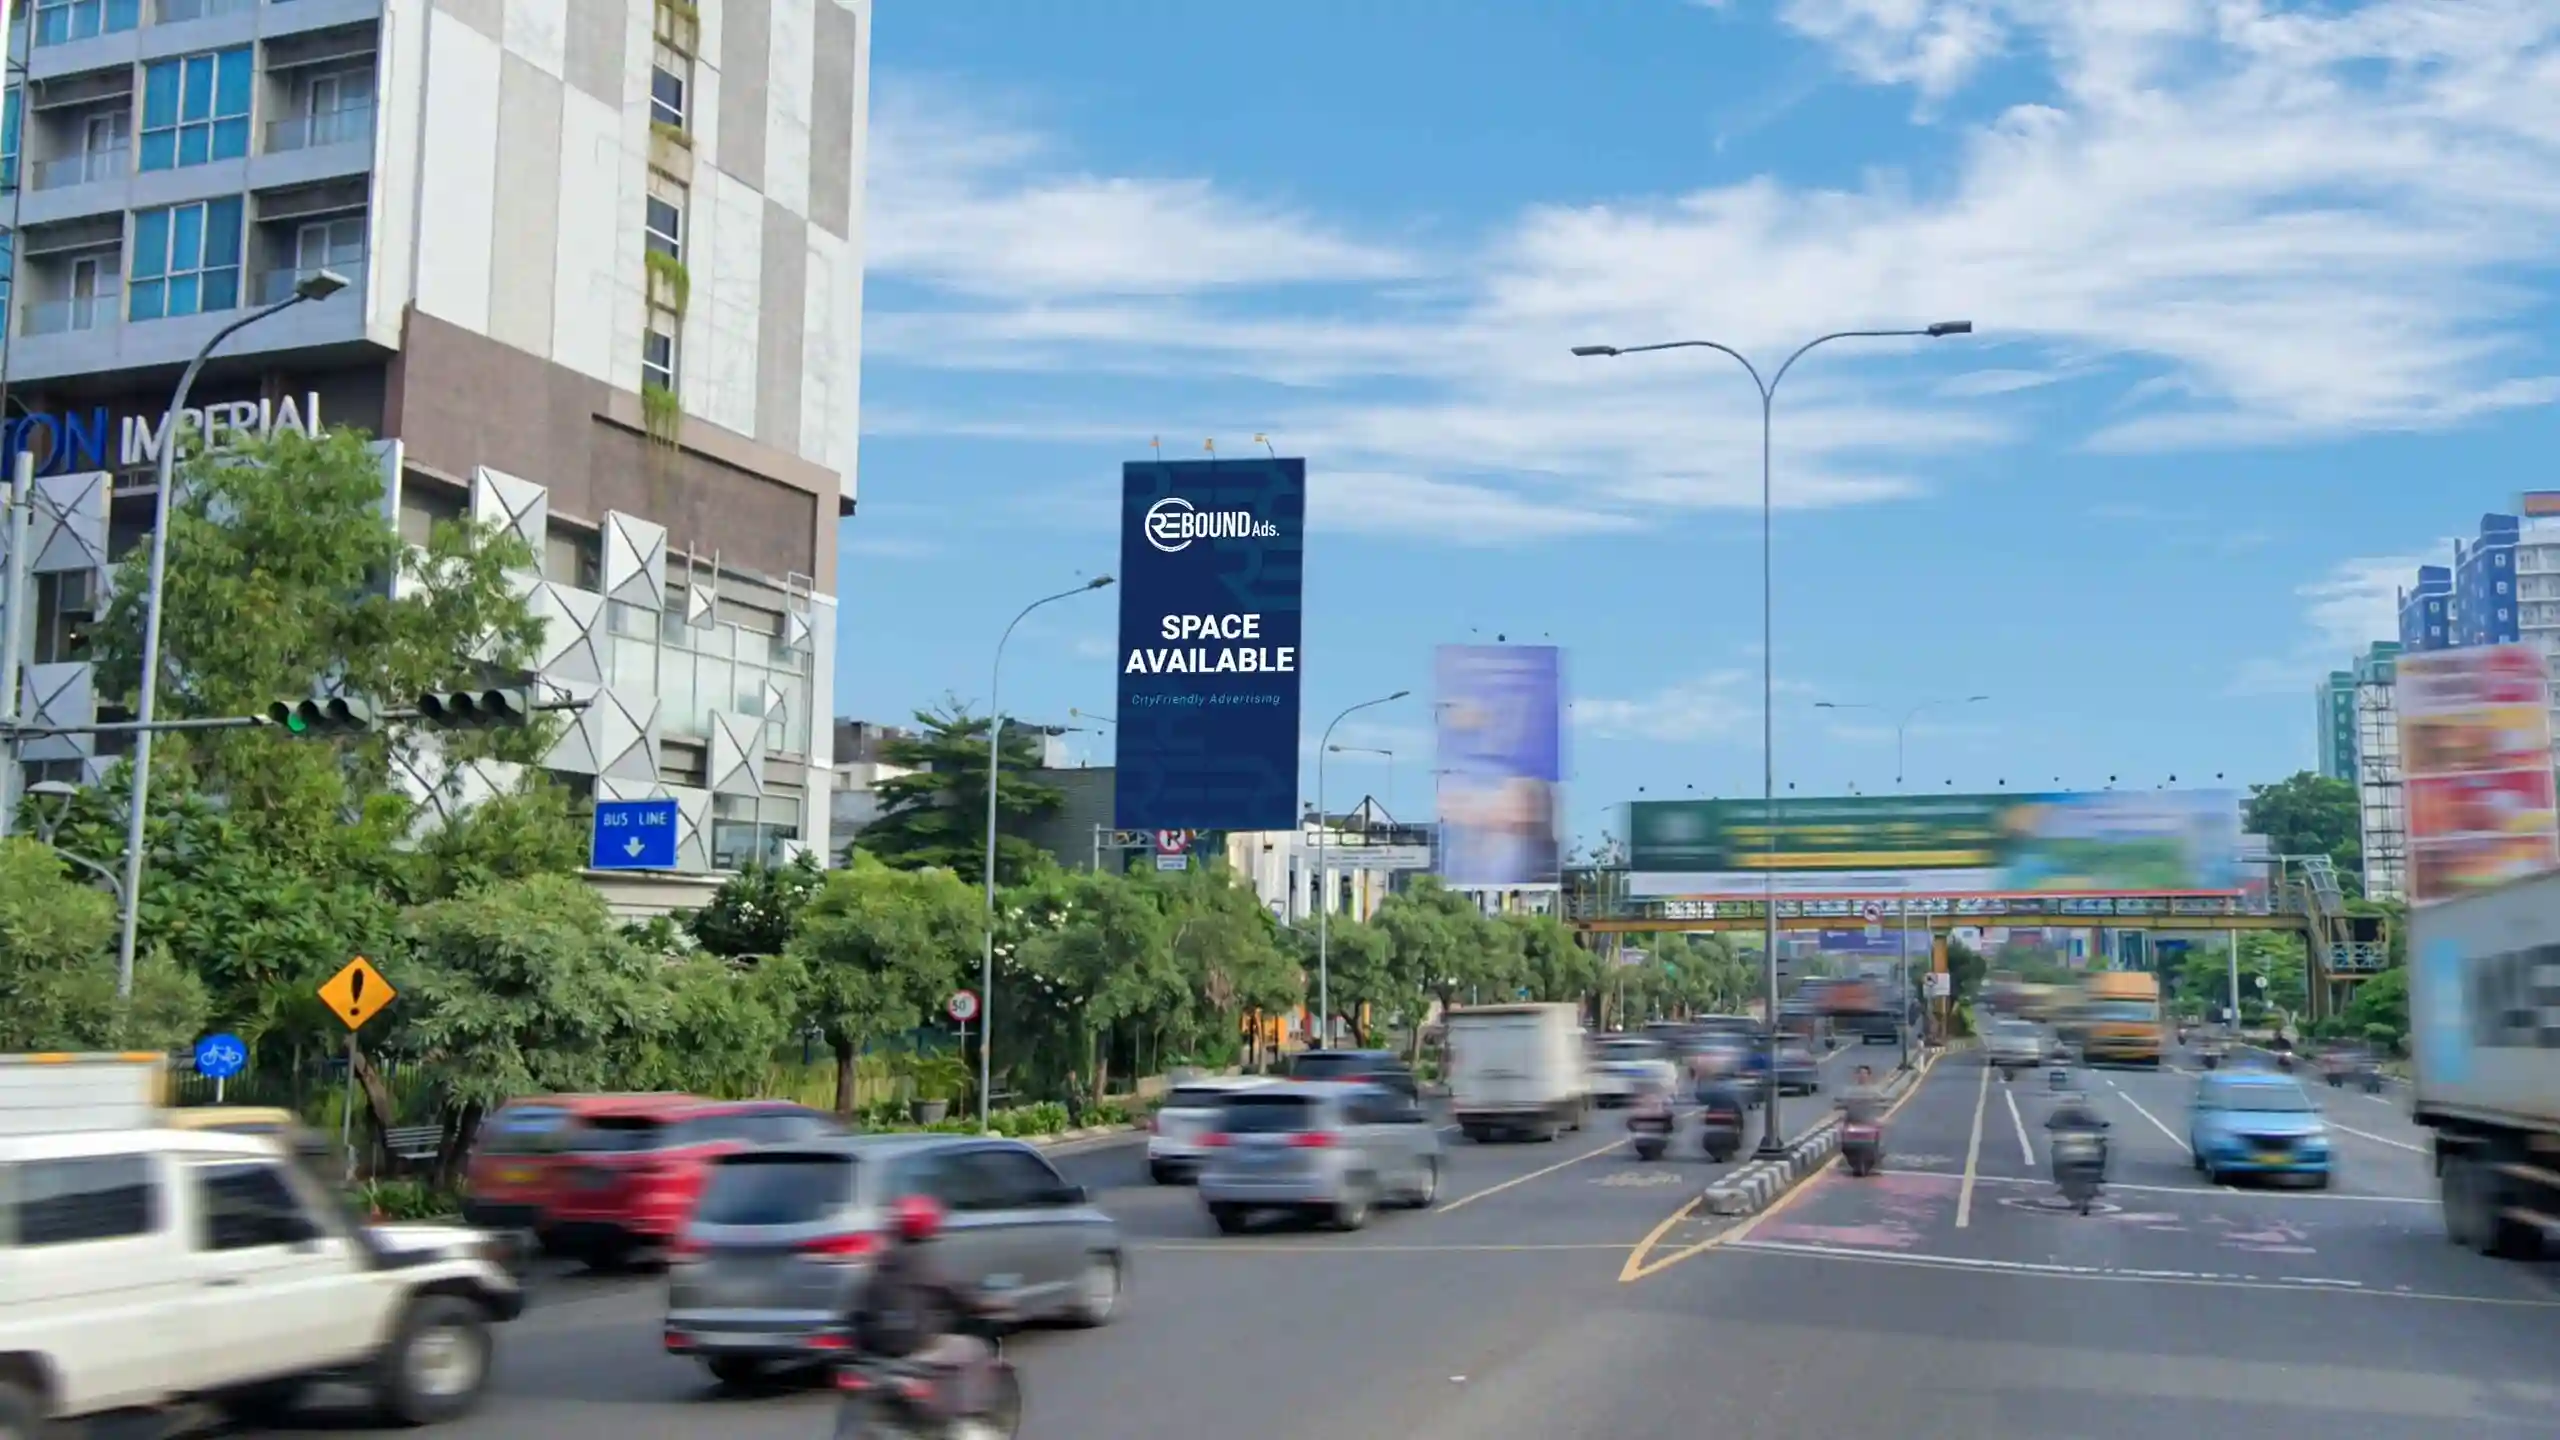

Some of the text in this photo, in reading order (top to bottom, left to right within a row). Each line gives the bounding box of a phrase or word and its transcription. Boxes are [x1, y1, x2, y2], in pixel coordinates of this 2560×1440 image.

[120, 391, 331, 465] IMPERIAL
[1149, 511, 1280, 539] REBOUND Ads.
[1161, 613, 1261, 640] SPACE
[1124, 646, 1295, 674] AVAILABLE
[1132, 692, 1281, 707] CityFriendly Advertising
[603, 811, 668, 827] BUS LINE
